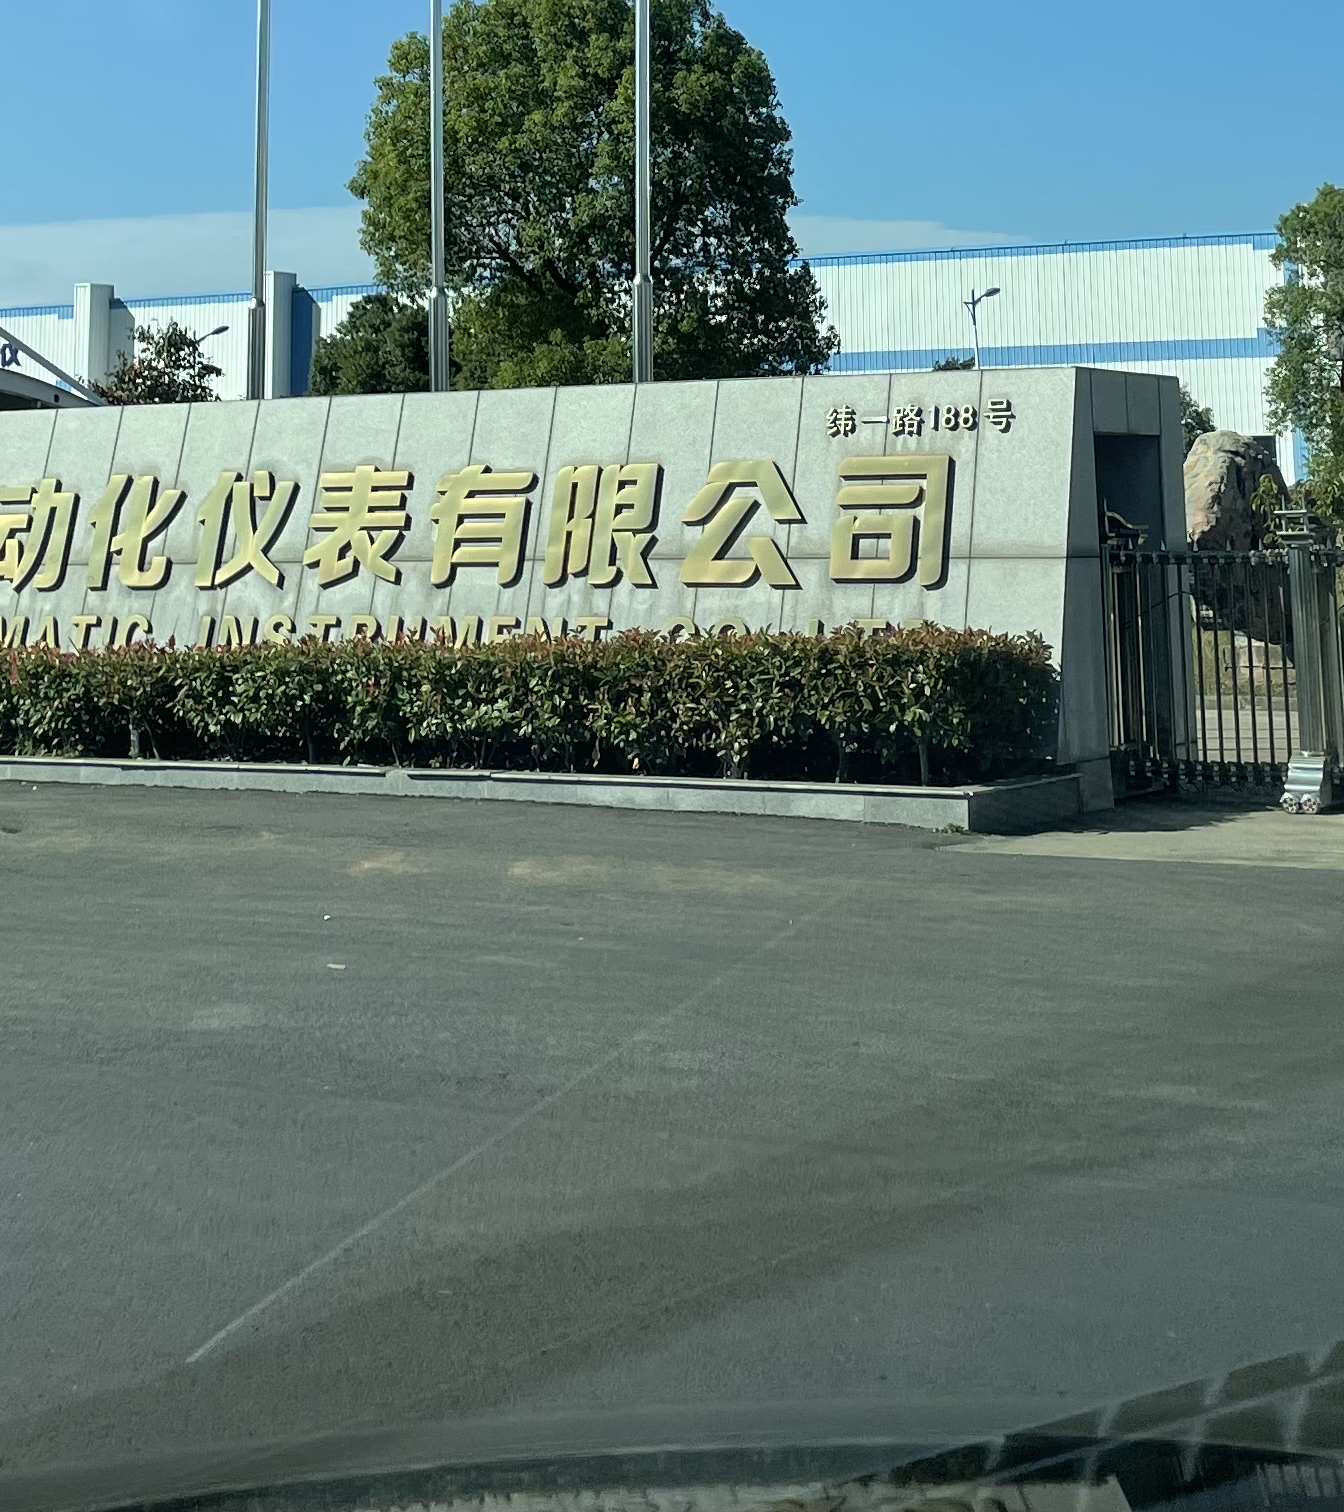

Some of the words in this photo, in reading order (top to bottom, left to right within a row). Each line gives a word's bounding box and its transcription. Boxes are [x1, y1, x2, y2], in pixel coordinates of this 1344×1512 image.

[825, 398, 1016, 438] 纬一路188号
[197, 613, 614, 648] INSTRUMENT
